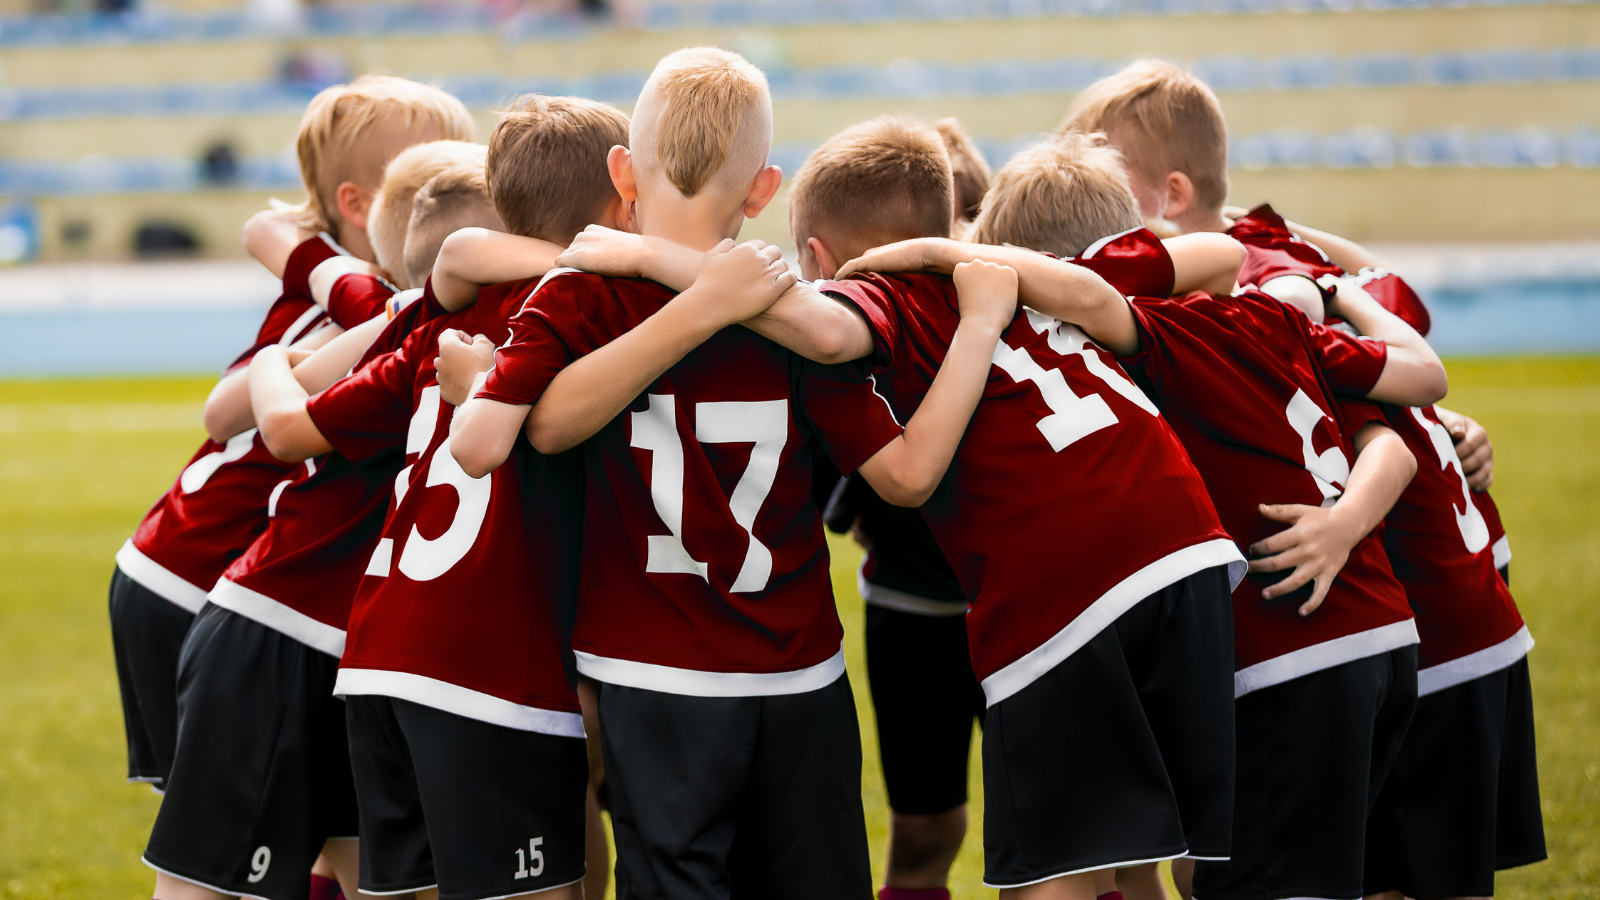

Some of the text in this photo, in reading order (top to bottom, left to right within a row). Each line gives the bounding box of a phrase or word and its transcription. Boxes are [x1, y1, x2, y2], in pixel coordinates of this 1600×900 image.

[364, 384, 492, 581] 15
[630, 393, 788, 593] 17
[247, 845, 271, 883] 9
[514, 836, 544, 880] 15
